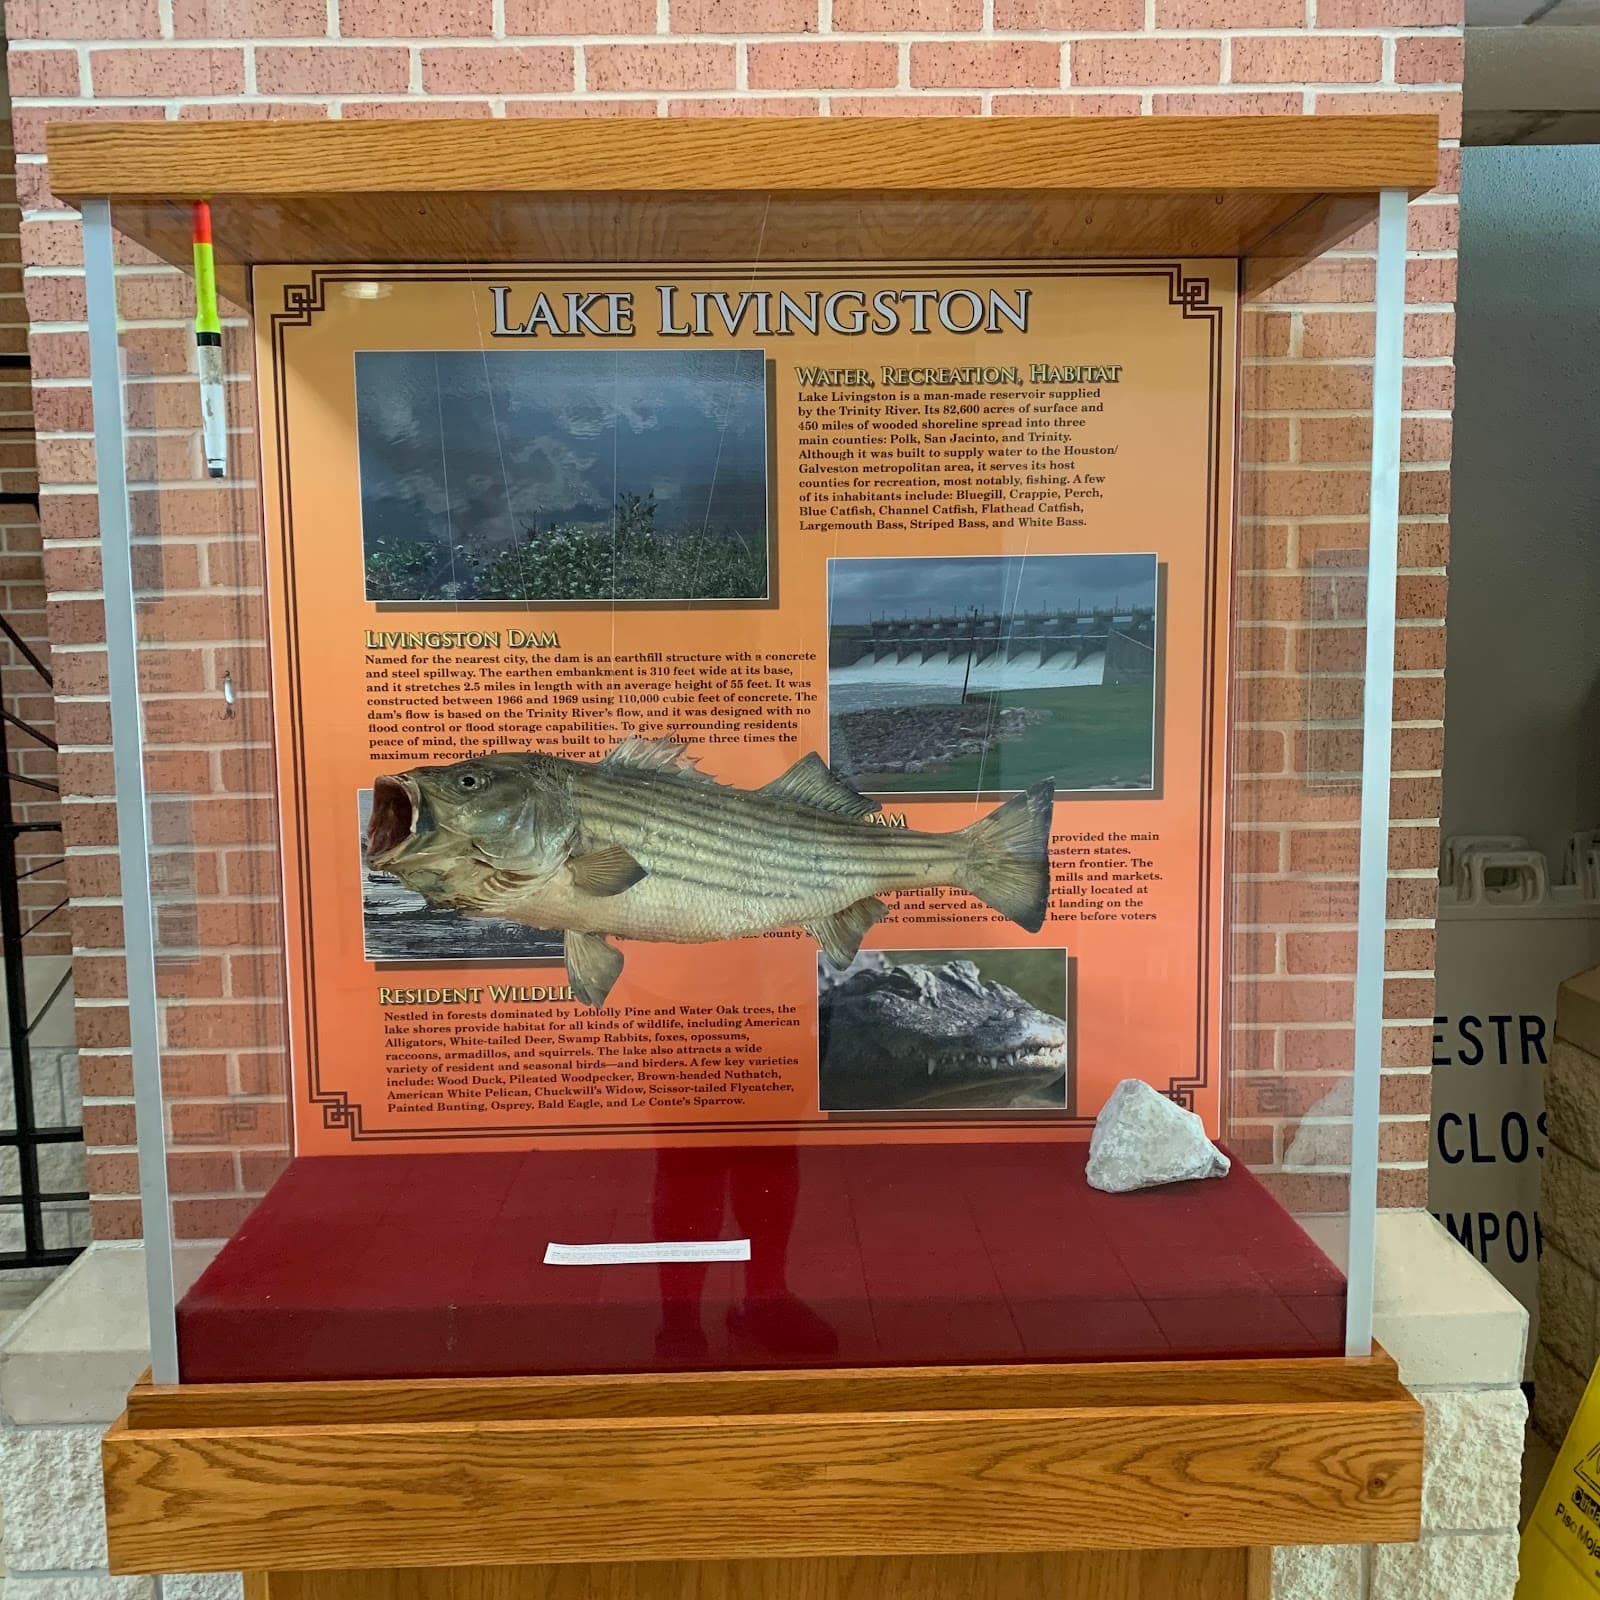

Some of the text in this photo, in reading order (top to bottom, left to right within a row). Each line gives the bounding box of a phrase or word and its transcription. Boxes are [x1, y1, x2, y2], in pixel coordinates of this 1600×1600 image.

[490, 286, 1032, 337] LAKE LIVINGSTON
[795, 363, 1122, 387] WATER, RECREATION, HABITAT
[798, 392, 828, 401] Lake
[831, 391, 896, 402] Livingston
[900, 391, 909, 400] is
[923, 390, 986, 399] man-made
[989, 390, 1045, 399] reservoir
[1048, 388, 1100, 400] supplied
[798, 417, 1085, 430] 450 miles of wooded shoreline spread into three
[798, 431, 1071, 444] main counties: Polk, San Jacinto, and Trinity.
[799, 463, 858, 473] Galveston
[862, 462, 940, 474] metropolitan
[944, 464, 974, 472] area,
[977, 461, 986, 470] it
[1031, 460, 1046, 469] its
[1049, 460, 1074, 469] host
[799, 487, 1102, 501] of its inhabitants include: Bluegill, Crappie, Perch,
[799, 502, 1083, 516] Blue Catfish, Channel Catfish, Flathead Catfish,
[799, 516, 1086, 531] Largemouth Bass, Striped Bass, and White Bass.
[365, 629, 560, 649] LIVINGSTON DAM
[365, 654, 407, 664] Named
[411, 654, 429, 663] for
[432, 654, 451, 663] the
[455, 654, 500, 663] nearest
[503, 654, 528, 665] city,
[531, 653, 550, 662] the
[554, 653, 579, 662] dam
[583, 653, 593, 662] is
[614, 652, 662, 662] earthfill
[665, 652, 721, 661] structure
[725, 651, 751, 660] with
[765, 652, 816, 660] concrete
[366, 692, 817, 705] constructed between 1966 and 1969 using 110,000 cubic feet of concrete. The
[368, 723, 398, 732] flood
[402, 723, 444, 732] control
[466, 722, 494, 731] flood
[498, 722, 542, 733] storage
[545, 721, 617, 732] capabilities.
[620, 721, 635, 730] To
[638, 721, 663, 732] give
[666, 720, 740, 731] surrounding
[743, 719, 797, 729] residents
[709, 733, 797, 742] three times the
[369, 750, 429, 759] maximum
[433, 749, 488, 759] recorded
[1052, 832, 1159, 843] provided the main
[1093, 846, 1130, 854] states.
[1055, 871, 1162, 880] mills and markets.
[1059, 898, 1104, 909] landing
[1125, 898, 1143, 906] the
[1050, 911, 1156, 920] here before voters
[378, 986, 484, 1004] RESIDENT
[384, 1032, 749, 1048] Alligators, White-tailed Deer, Swamp Rabbits, foxes, opossums,
[1432, 1015, 1556, 1066] ESTR
[387, 1069, 781, 1086] include: Wood Duck, Pileated Woodpecker, Brown-headed Nuthatch,
[387, 1081, 793, 1099] American White Pelican, Chuckwill's Widow, Scissor-tailed Flycatcher,
[388, 1095, 744, 1112] Painted Bunting, Osprey, Bald Eagle, and Le Conte's Sparrow.
[1555, 1502, 1577, 1533] Piso
